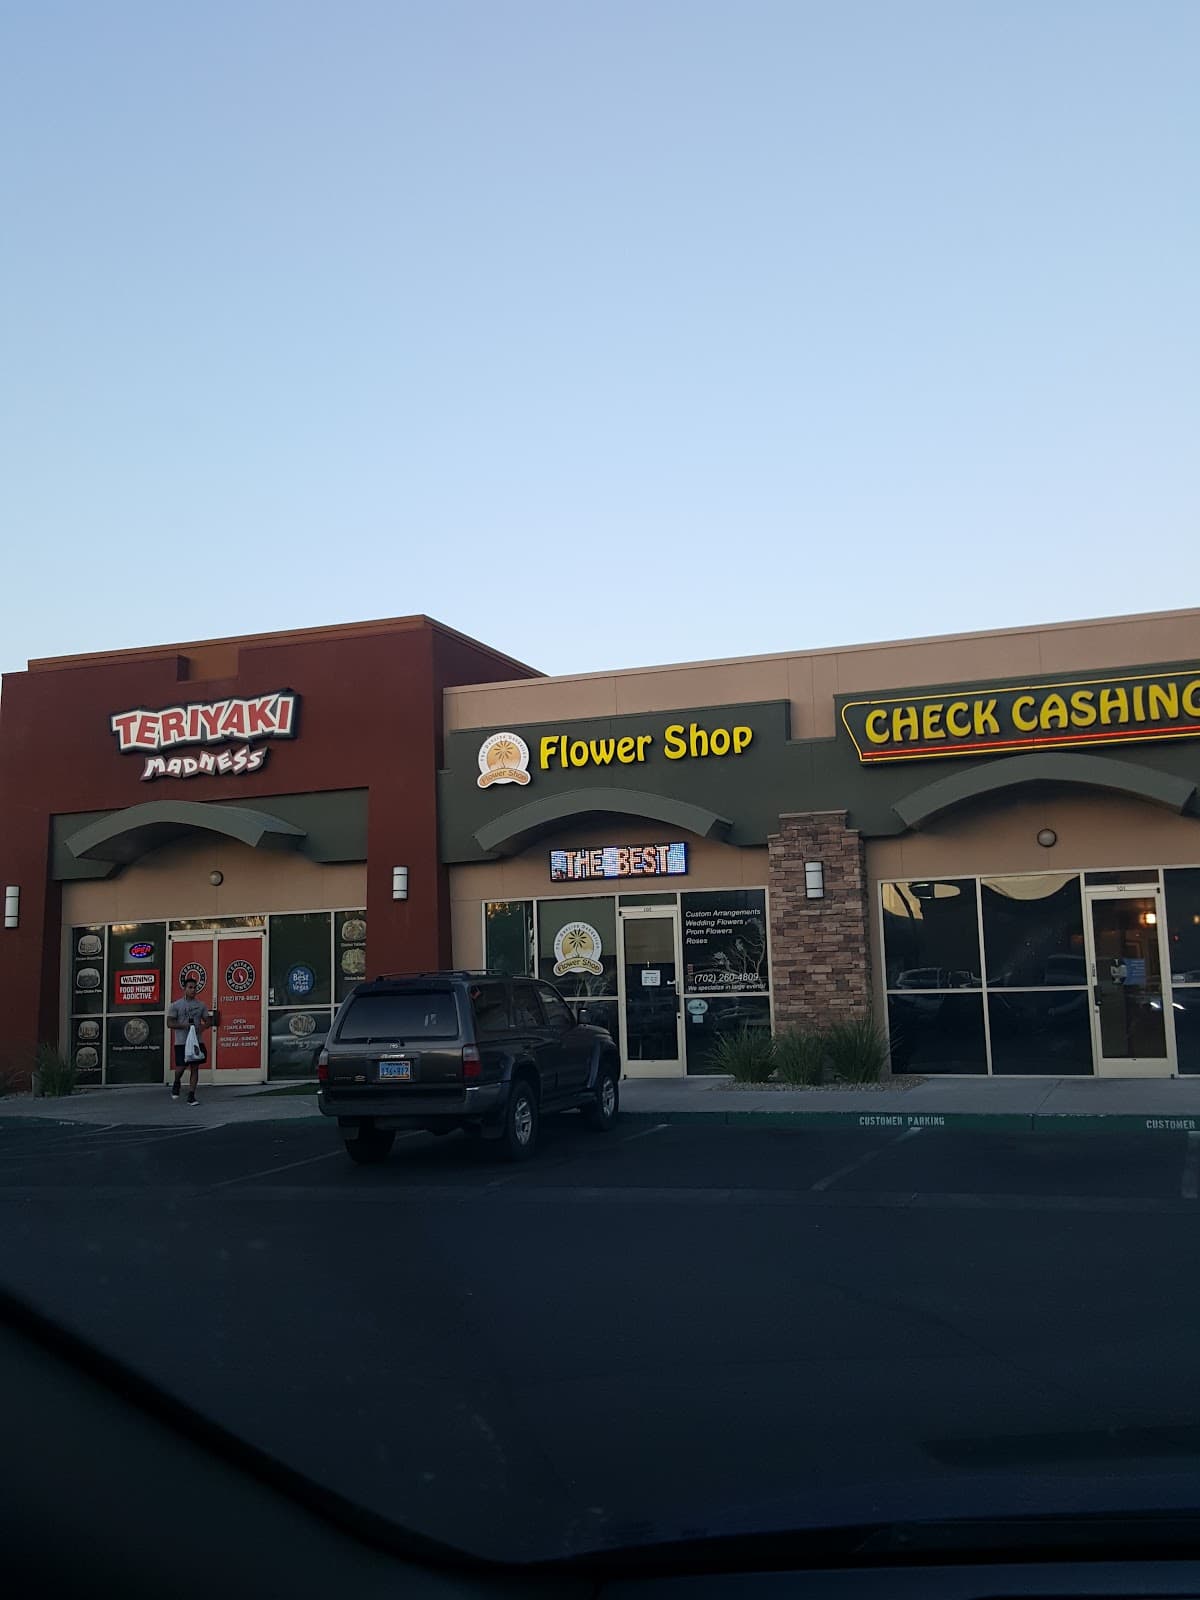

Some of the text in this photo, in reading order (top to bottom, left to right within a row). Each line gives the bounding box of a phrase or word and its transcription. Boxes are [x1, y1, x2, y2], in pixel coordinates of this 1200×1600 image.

[112, 694, 295, 749] TERIYAKI
[865, 700, 1000, 744] CHECK
[539, 723, 754, 770] Flower Shop
[142, 748, 266, 779] MADNESS
[563, 845, 670, 879] THE BEST
[713, 909, 761, 919] Arrangements
[685, 918, 744, 928] Wedding Flowers
[685, 927, 733, 936] Prom Flowers
[686, 937, 708, 945] Roses
[130, 945, 152, 955] OPEN
[121, 975, 154, 984] WARNING
[292, 973, 310, 982] Best
[694, 973, 717, 984] (702)
[119, 985, 155, 994] FOOD HIGHLY
[122, 992, 153, 1001] ADDICTIVE
[858, 1116, 945, 1126] CUSTOMER PARKING
[1146, 1119, 1196, 1129] CUSTOMER
